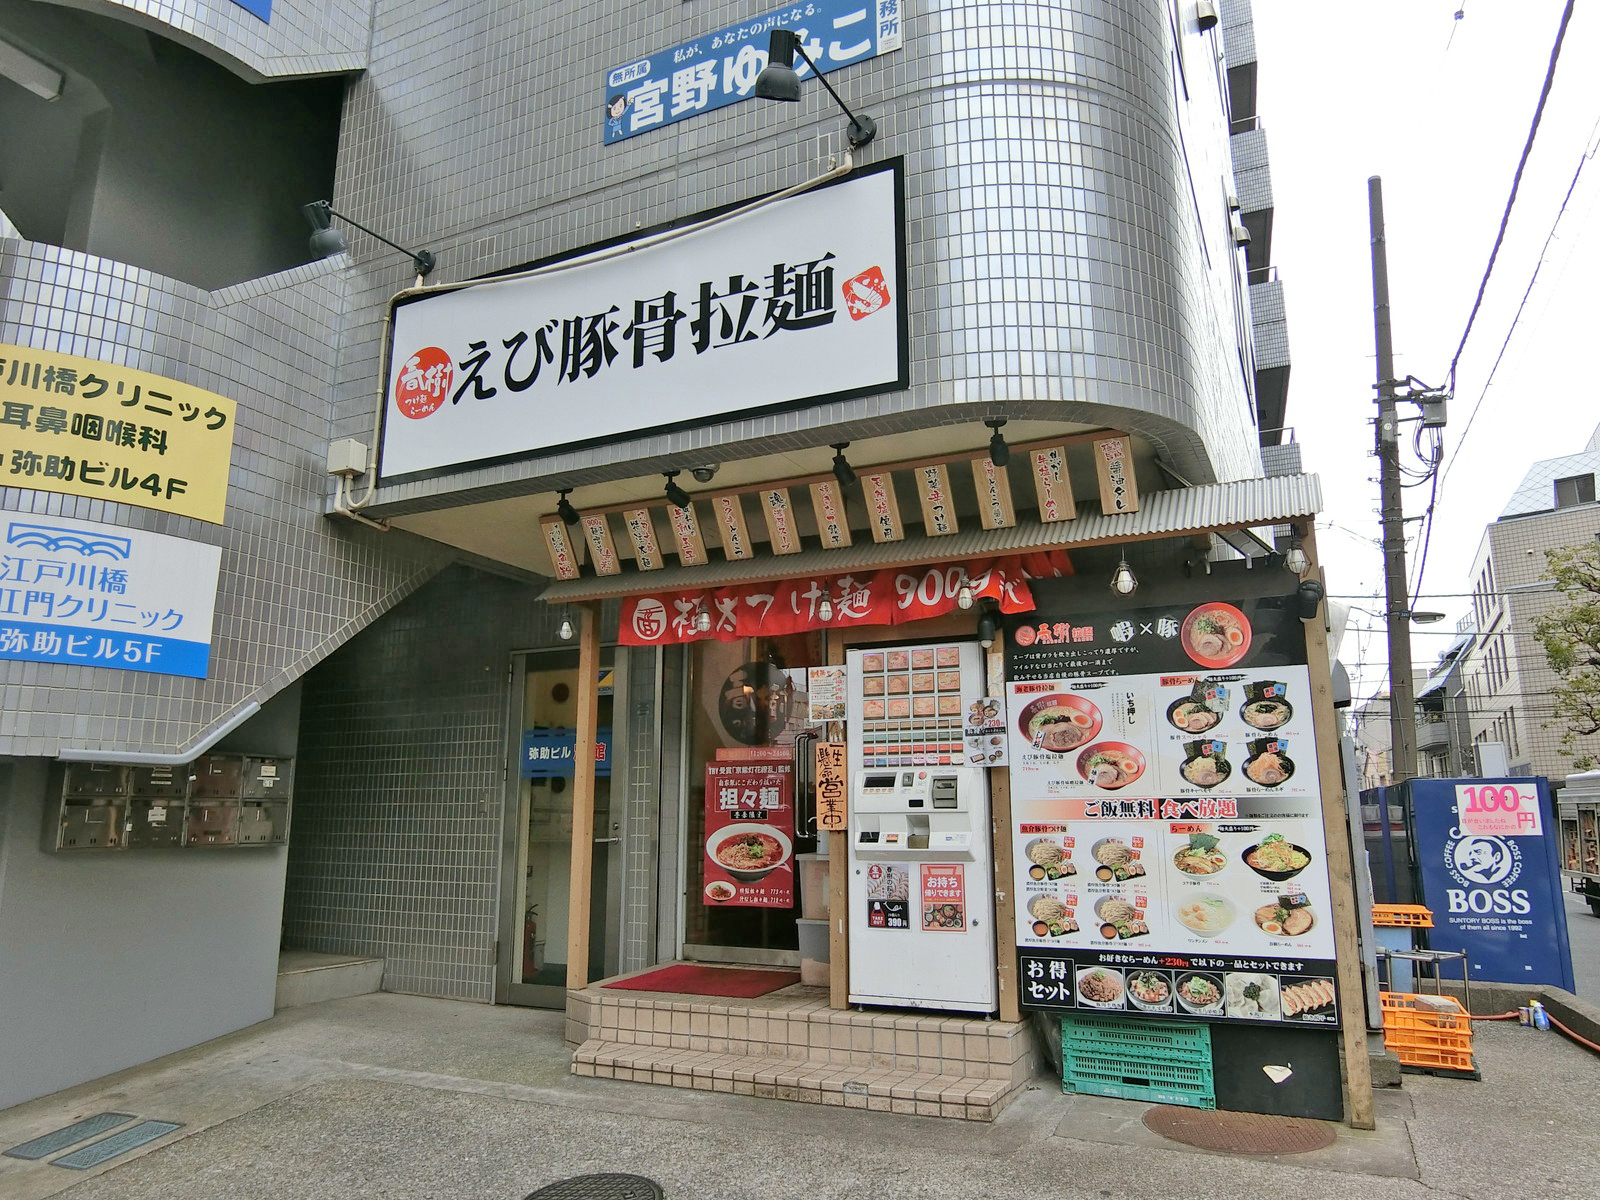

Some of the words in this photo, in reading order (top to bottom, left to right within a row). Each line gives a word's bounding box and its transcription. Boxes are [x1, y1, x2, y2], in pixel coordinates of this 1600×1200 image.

[611, 62, 649, 84] 無所属
[451, 251, 837, 406] えび豚骨拉麺
[0, 401, 168, 455] 耳鼻咽喉科
[10, 449, 188, 500] 弥助ビル4F
[0, 555, 129, 595] 江戸川橋
[1, 628, 163, 664] 弥助ビル5F
[1126, 691, 1136, 725] いち押し
[528, 746, 571, 760] 弥助ビル
[719, 786, 780, 810] 担々麺
[817, 776, 845, 828] 営業中
[1171, 825, 1202, 833] らーめん
[1517, 811, 1536, 829] 円
[1443, 839, 1456, 869] COFFEE
[1506, 839, 1522, 861] BOSS
[927, 876, 958, 888] お持ち
[1449, 869, 1470, 888] BOSS
[1501, 861, 1523, 888] COFFEE
[924, 889, 962, 898] 帰りできます
[1447, 889, 1531, 915] BOSS
[1027, 960, 1067, 980] お得
[1028, 981, 1071, 1001] セット
